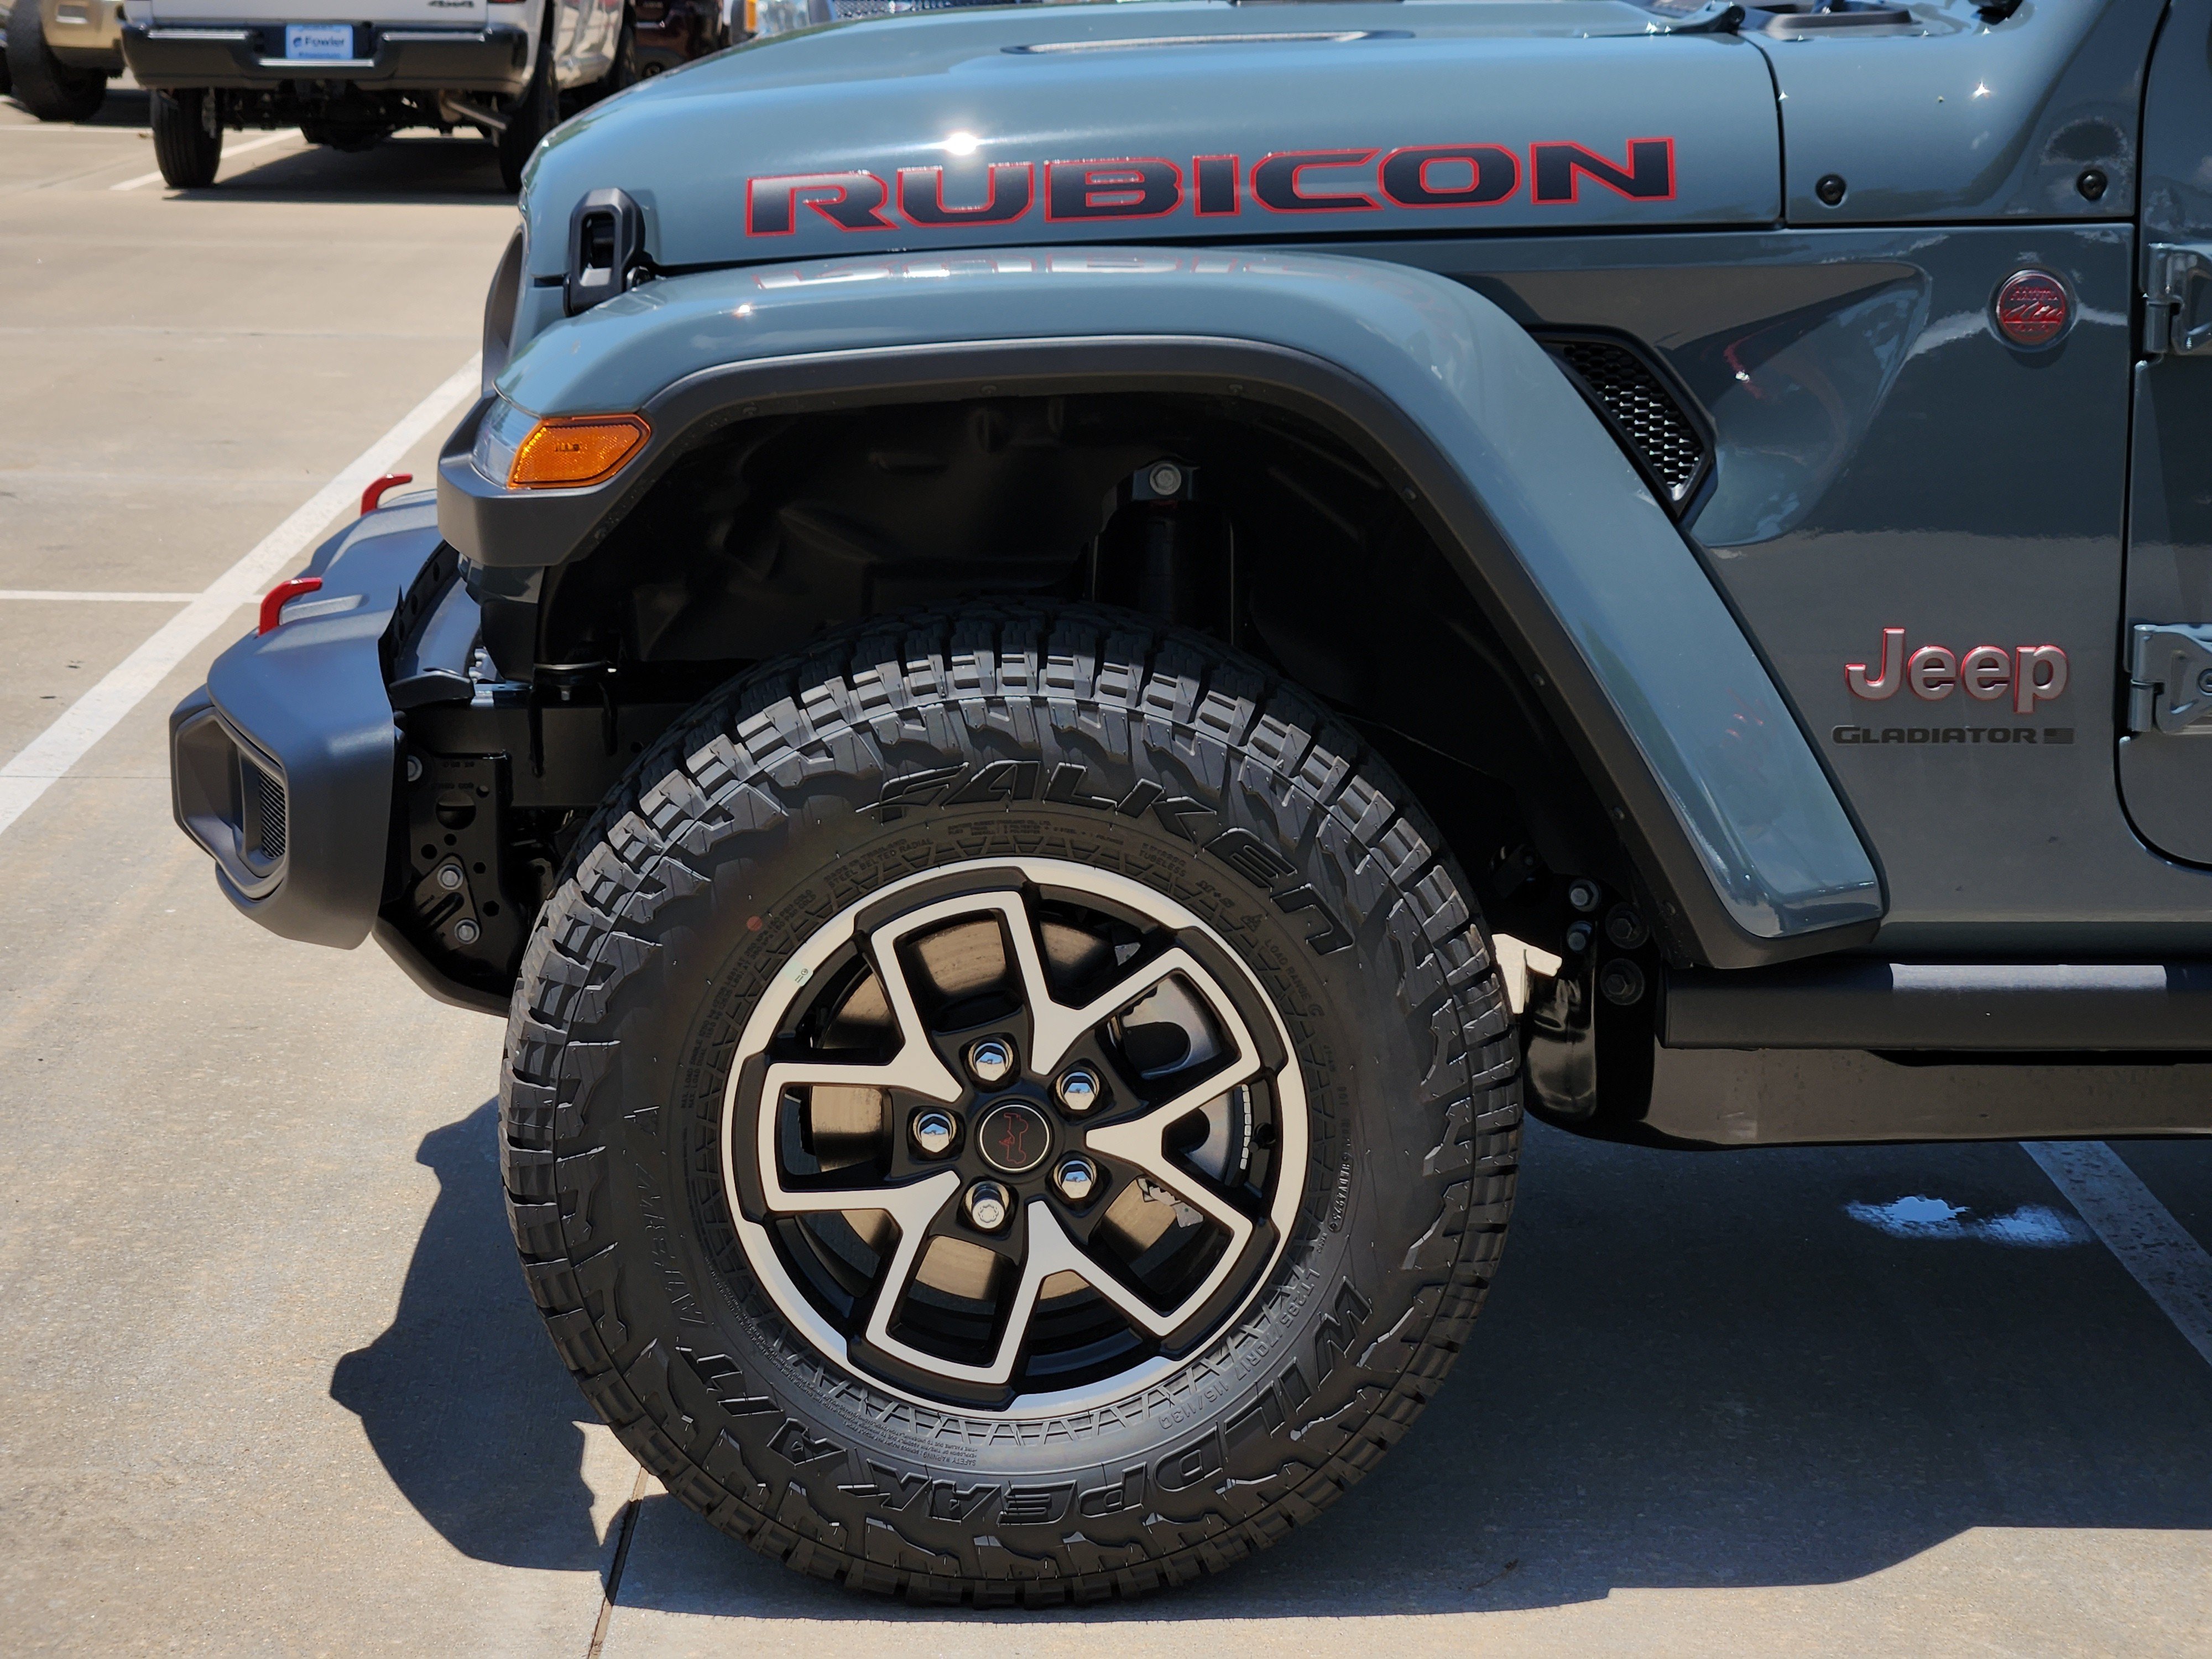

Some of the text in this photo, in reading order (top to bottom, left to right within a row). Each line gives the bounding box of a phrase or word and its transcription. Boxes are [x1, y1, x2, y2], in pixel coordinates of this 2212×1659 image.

[305, 36, 345, 46] Fowler
[745, 136, 1676, 238] RUBICON
[1844, 627, 2070, 714] Jeep
[1832, 725, 2038, 744] GLADIATOR
[1264, 937, 1289, 966] LOAD
[1284, 965, 1311, 1001] RANGE
[1229, 1267, 1323, 1381] LT285/70R17
[837, 1275, 1373, 1525] WILDPEAK
[951, 1456, 977, 1467] SAFETY
